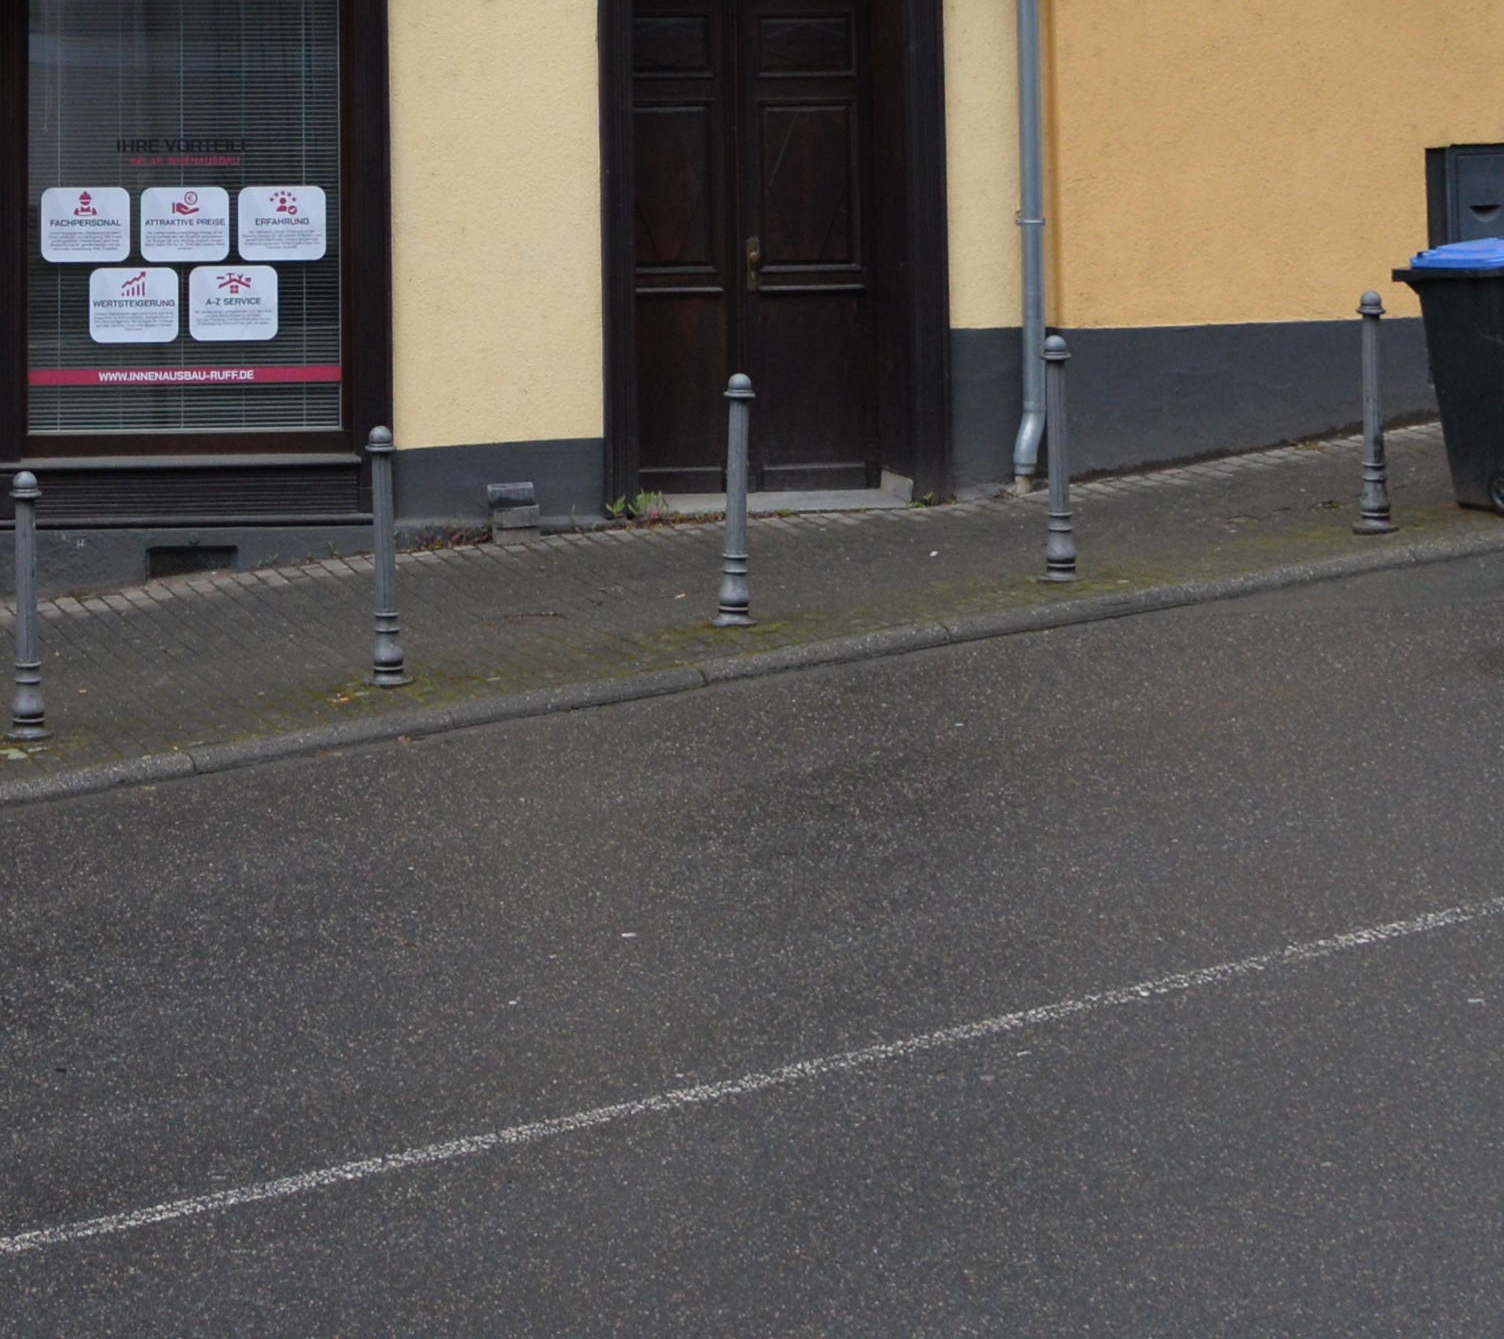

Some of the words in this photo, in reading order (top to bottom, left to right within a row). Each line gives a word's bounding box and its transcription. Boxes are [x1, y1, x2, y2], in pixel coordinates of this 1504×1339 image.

[116, 138, 160, 153] IHRE
[49, 218, 123, 228] FACHPERSONAL
[144, 218, 195, 227] ATTRAKTIVE
[196, 218, 226, 227] PREISE
[254, 217, 310, 227] ERFAHRUNG
[92, 299, 176, 309] WERTSTEIGERUNG
[205, 297, 222, 306] A-Z
[223, 297, 262, 306] SERVICE
[98, 369, 255, 383] WWW.INNENAUSBAU-RUFF.DE
